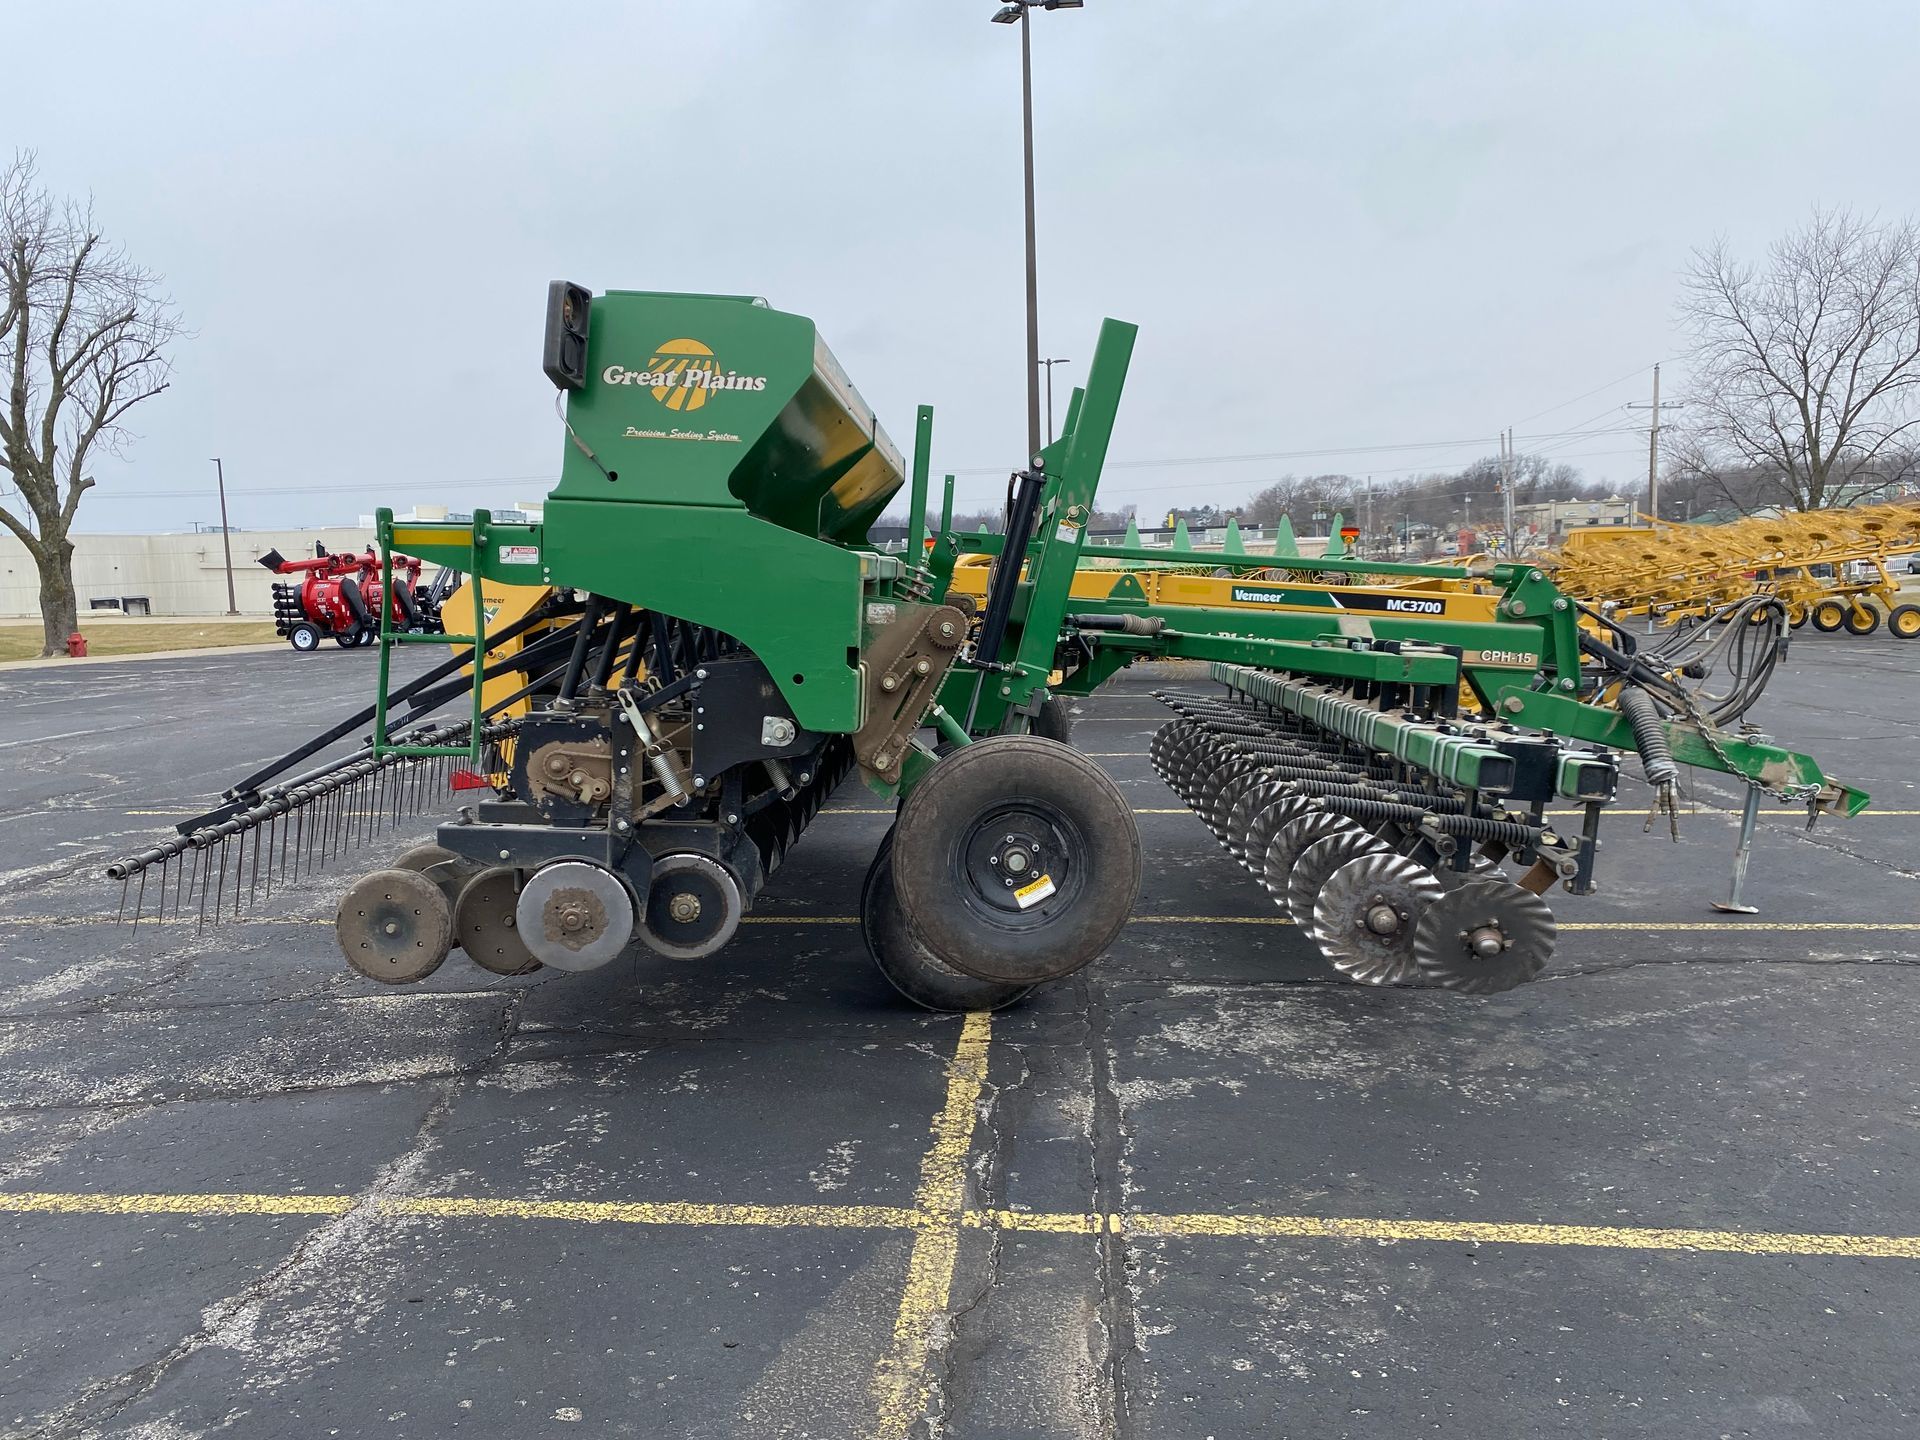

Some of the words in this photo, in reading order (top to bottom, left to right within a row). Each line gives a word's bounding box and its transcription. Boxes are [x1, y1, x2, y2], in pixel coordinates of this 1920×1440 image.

[603, 365, 676, 388] Great
[682, 368, 767, 391] Plains
[626, 427, 666, 437] Precision
[669, 428, 704, 441] Seeding
[707, 430, 739, 441] System
[1235, 589, 1283, 603] Vermeer
[1386, 599, 1442, 614] MC3700
[1481, 650, 1532, 664] CPH-15
[1024, 877, 1048, 894] CAUTION
